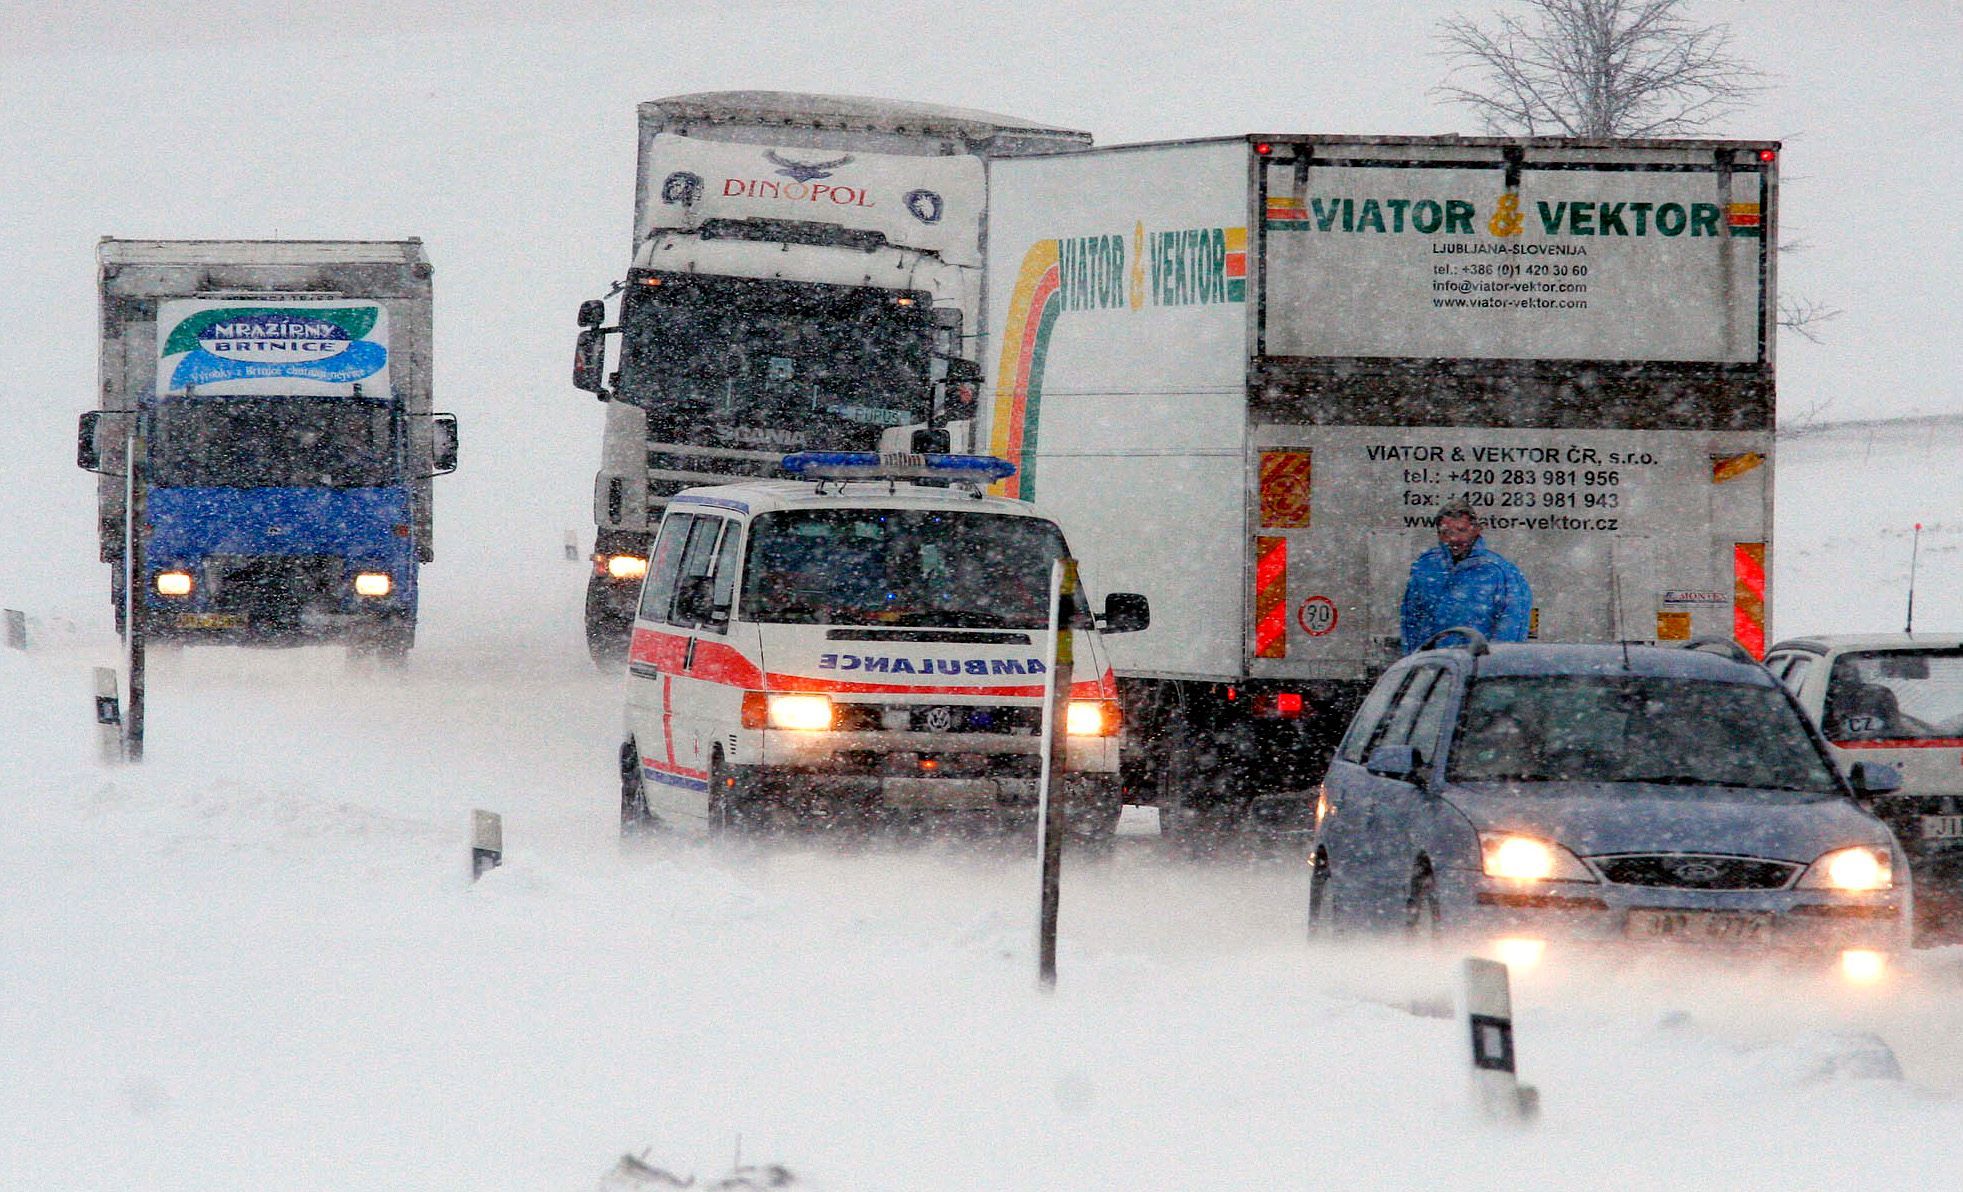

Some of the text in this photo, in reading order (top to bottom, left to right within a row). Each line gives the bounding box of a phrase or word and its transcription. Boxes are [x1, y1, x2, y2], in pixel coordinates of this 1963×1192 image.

[722, 178, 876, 208] DINOPOL
[1310, 192, 1721, 238] VIATOR & VEKTOR
[1432, 243, 1587, 256] LJUBLJANA-SLOVENIJA
[1058, 219, 1226, 313] VIATOR & VEKTOR
[1433, 264, 1588, 278] tel.: +386 (0)1 420 30 60
[1432, 280, 1587, 293] info@viator-vektor.com
[1433, 297, 1588, 309] www.viator-vektor.com
[214, 320, 337, 339] MRAZÍRNY
[214, 341, 335, 352] BRTNICE
[1366, 446, 1444, 462] VIATOR
[1451, 446, 1465, 462] &
[1472, 447, 1560, 464] VEKTOR
[1609, 452, 1659, 465] s.r.o.
[1403, 469, 1620, 486] tel.: +420 283 981 956
[1403, 490, 1440, 507] fax:
[1501, 491, 1536, 507] 283
[1543, 491, 1576, 508] 981
[1584, 492, 1619, 508] 943
[1850, 716, 1873, 732] CZ
[1936, 817, 1963, 836] JI
